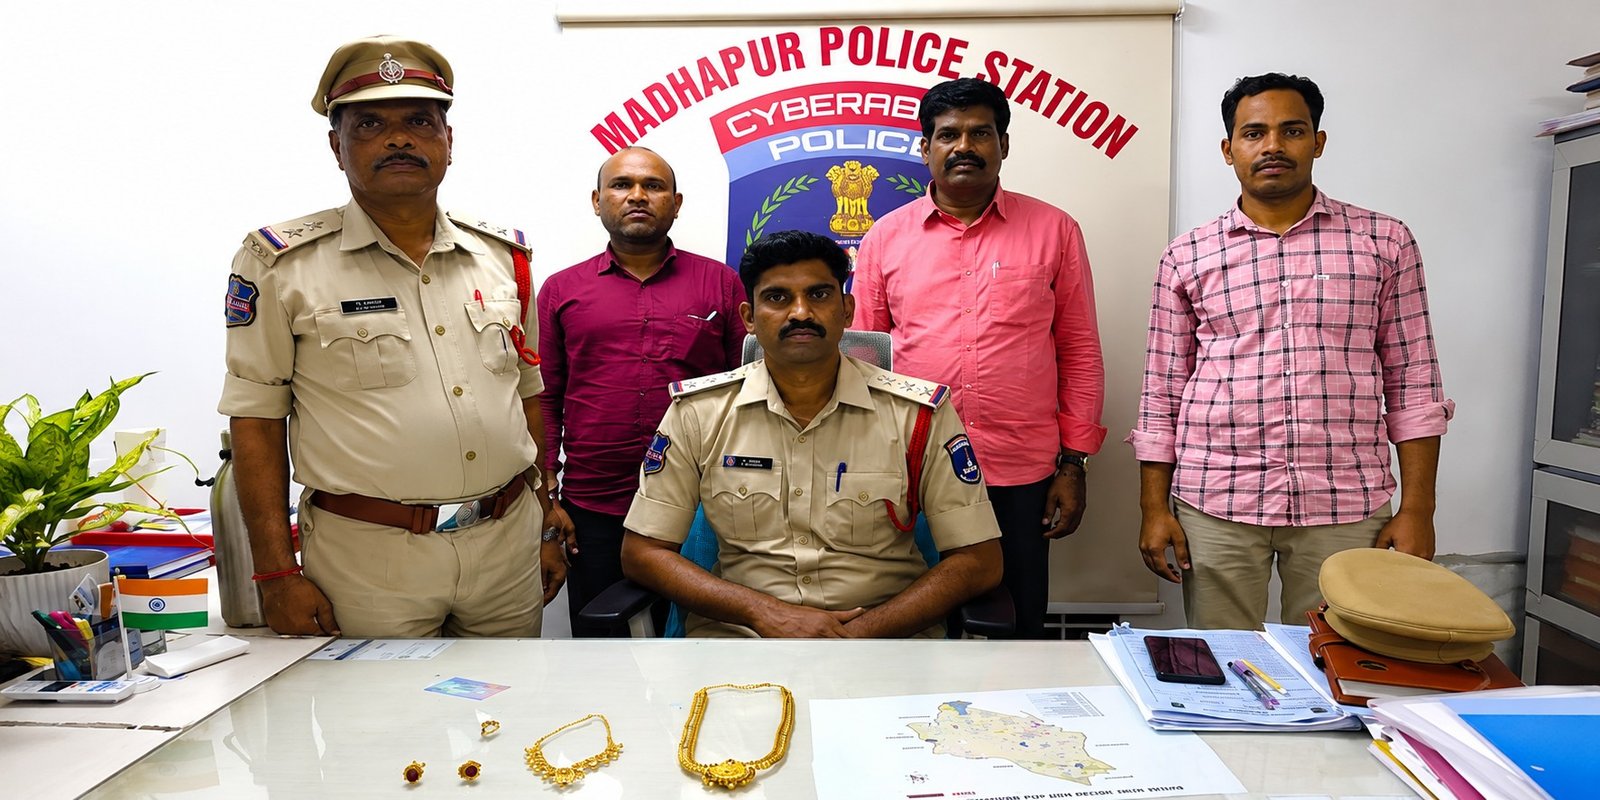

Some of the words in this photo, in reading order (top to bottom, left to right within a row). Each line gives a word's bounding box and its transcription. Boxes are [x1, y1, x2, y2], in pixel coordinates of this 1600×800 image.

[590, 32, 806, 155] MADHAPUR
[820, 25, 969, 79] POLICE
[975, 50, 1139, 160] STATION
[726, 92, 921, 138] CYBERAB
